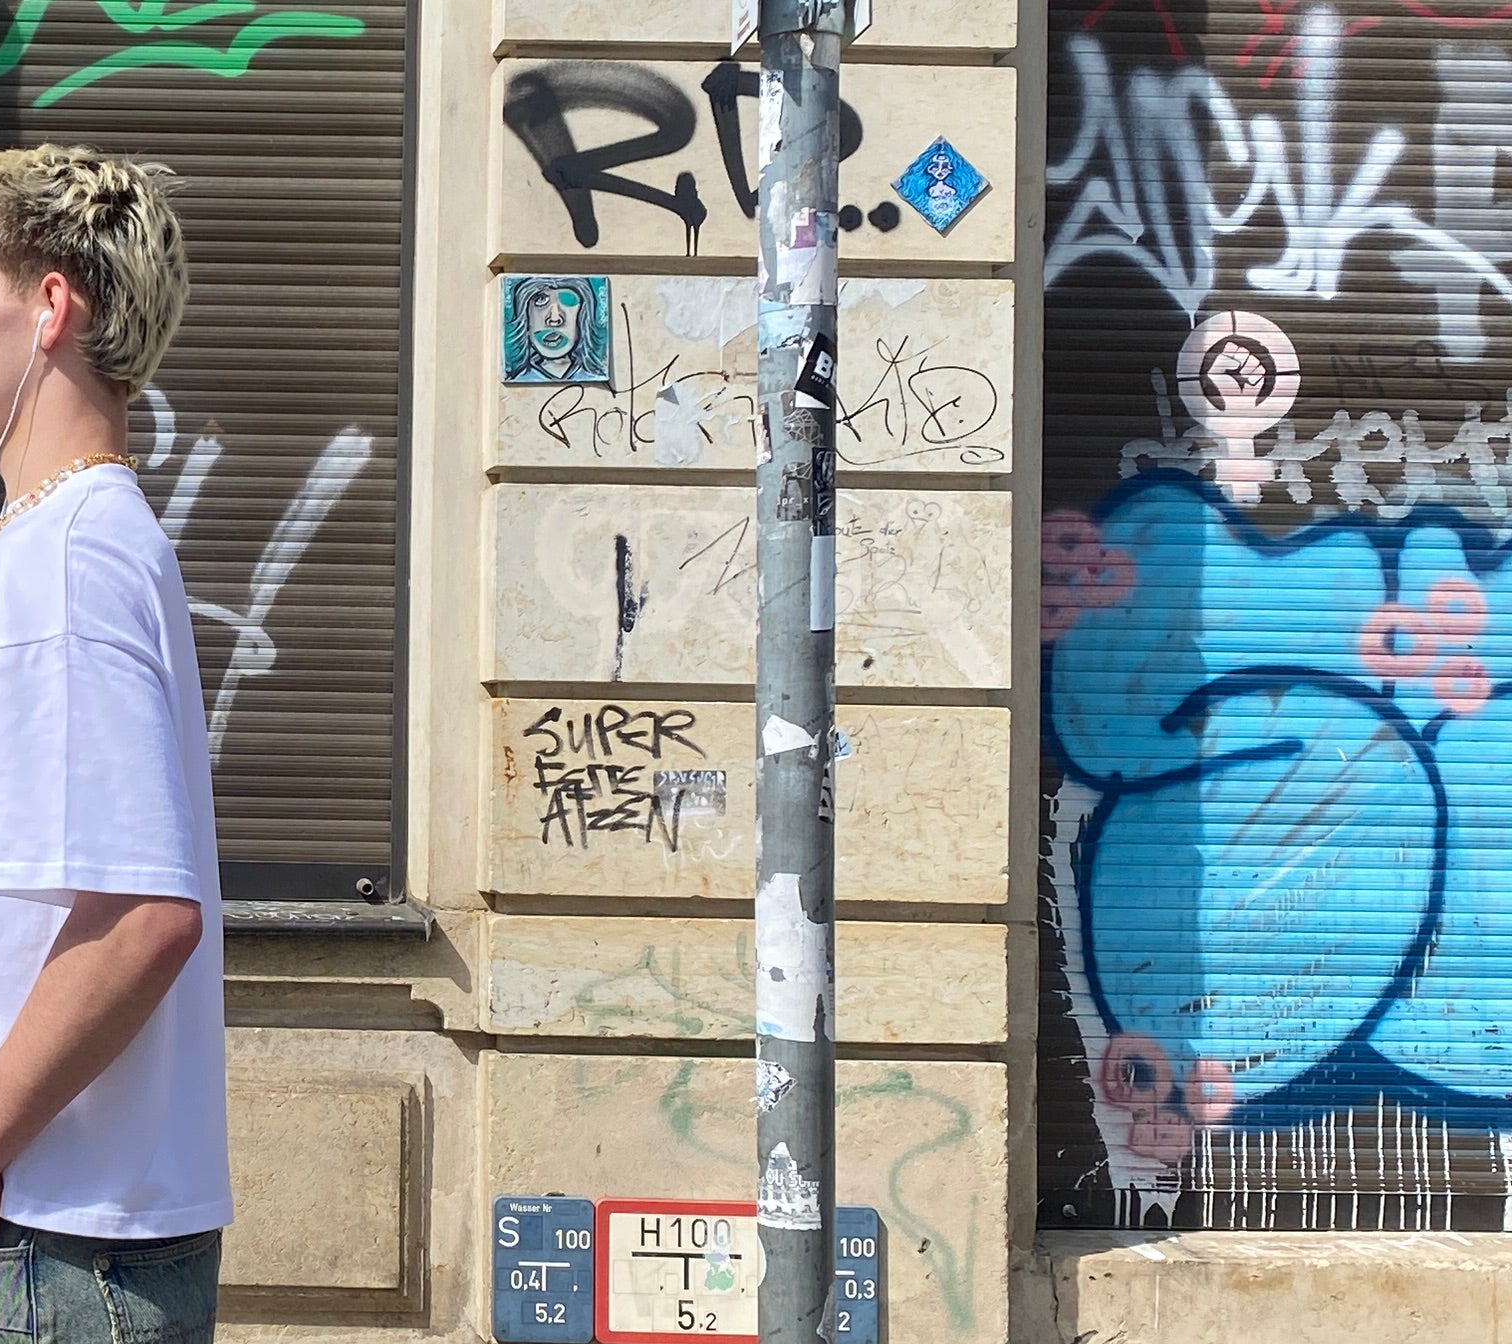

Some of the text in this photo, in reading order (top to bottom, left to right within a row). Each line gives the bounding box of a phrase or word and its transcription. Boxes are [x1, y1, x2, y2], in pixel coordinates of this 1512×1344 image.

[523, 703, 707, 760] SUPER
[510, 1203, 540, 1213] Wasser
[498, 1216, 591, 1249] S 100
[840, 1237, 876, 1258] 100
[510, 1270, 541, 1291] 0,4
[845, 1279, 876, 1299] 0,3
[535, 1302, 566, 1324] 5,2
[678, 1299, 717, 1331] 5,2
